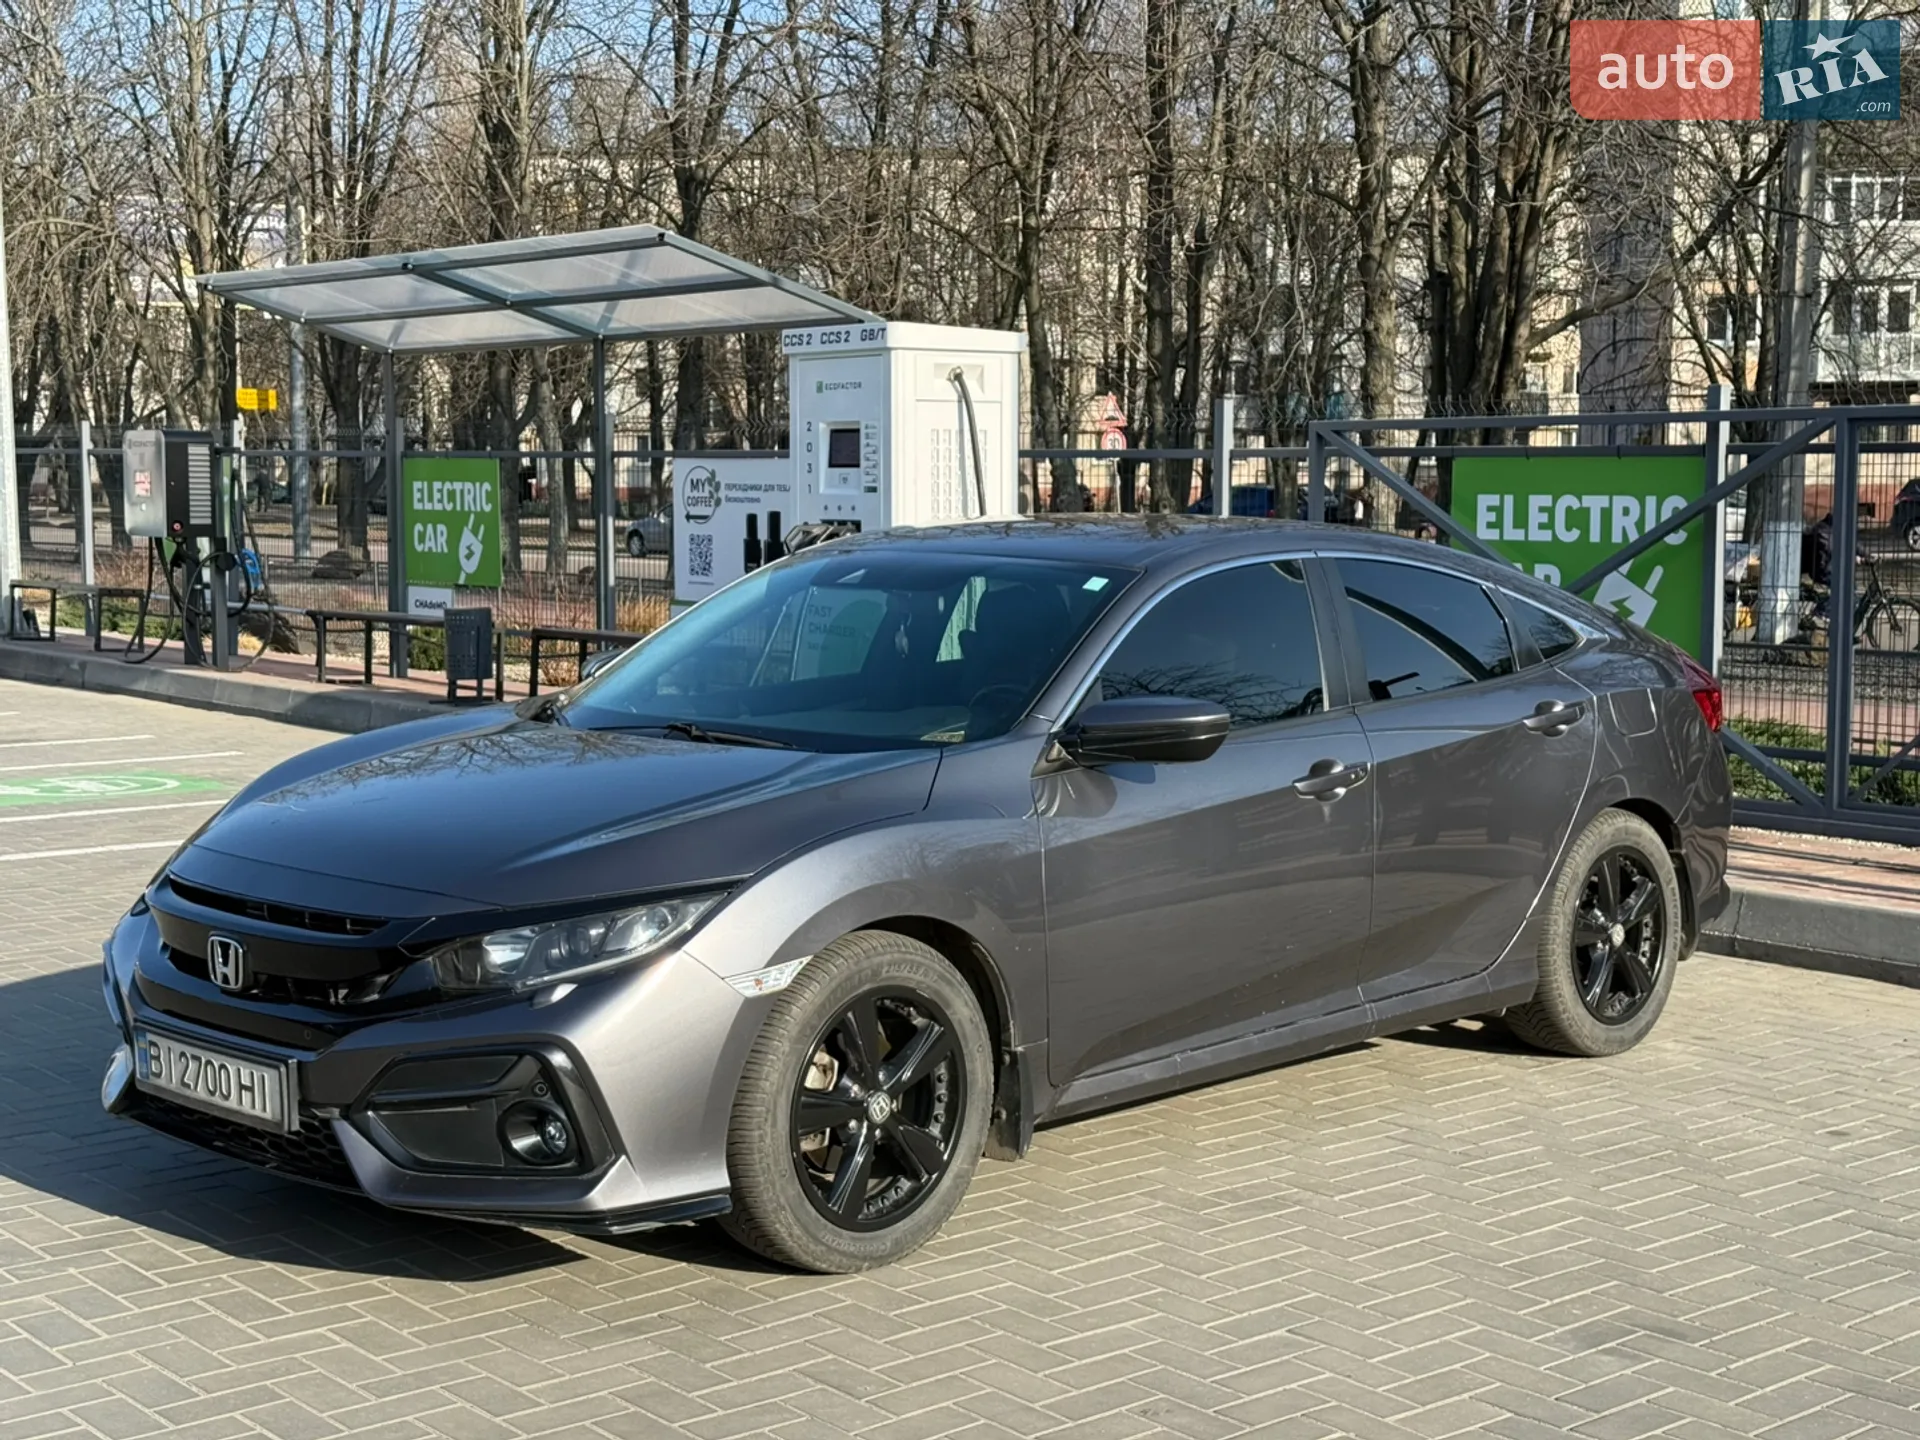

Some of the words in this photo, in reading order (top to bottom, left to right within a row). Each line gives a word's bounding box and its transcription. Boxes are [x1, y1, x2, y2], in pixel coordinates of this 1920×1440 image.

[783, 333, 804, 347] CCS
[806, 333, 813, 345] 2
[820, 330, 842, 345] CCS
[844, 330, 851, 343] 2
[860, 326, 887, 342] GB/T
[824, 381, 862, 391] ECOFACTOR
[412, 480, 493, 513] ELECTRIC
[690, 478, 708, 493] MY
[686, 495, 713, 508] COFFEE
[1476, 494, 1689, 546] ELECTRIC
[413, 522, 449, 554] CAR
[179, 1051, 233, 1101] 2700
